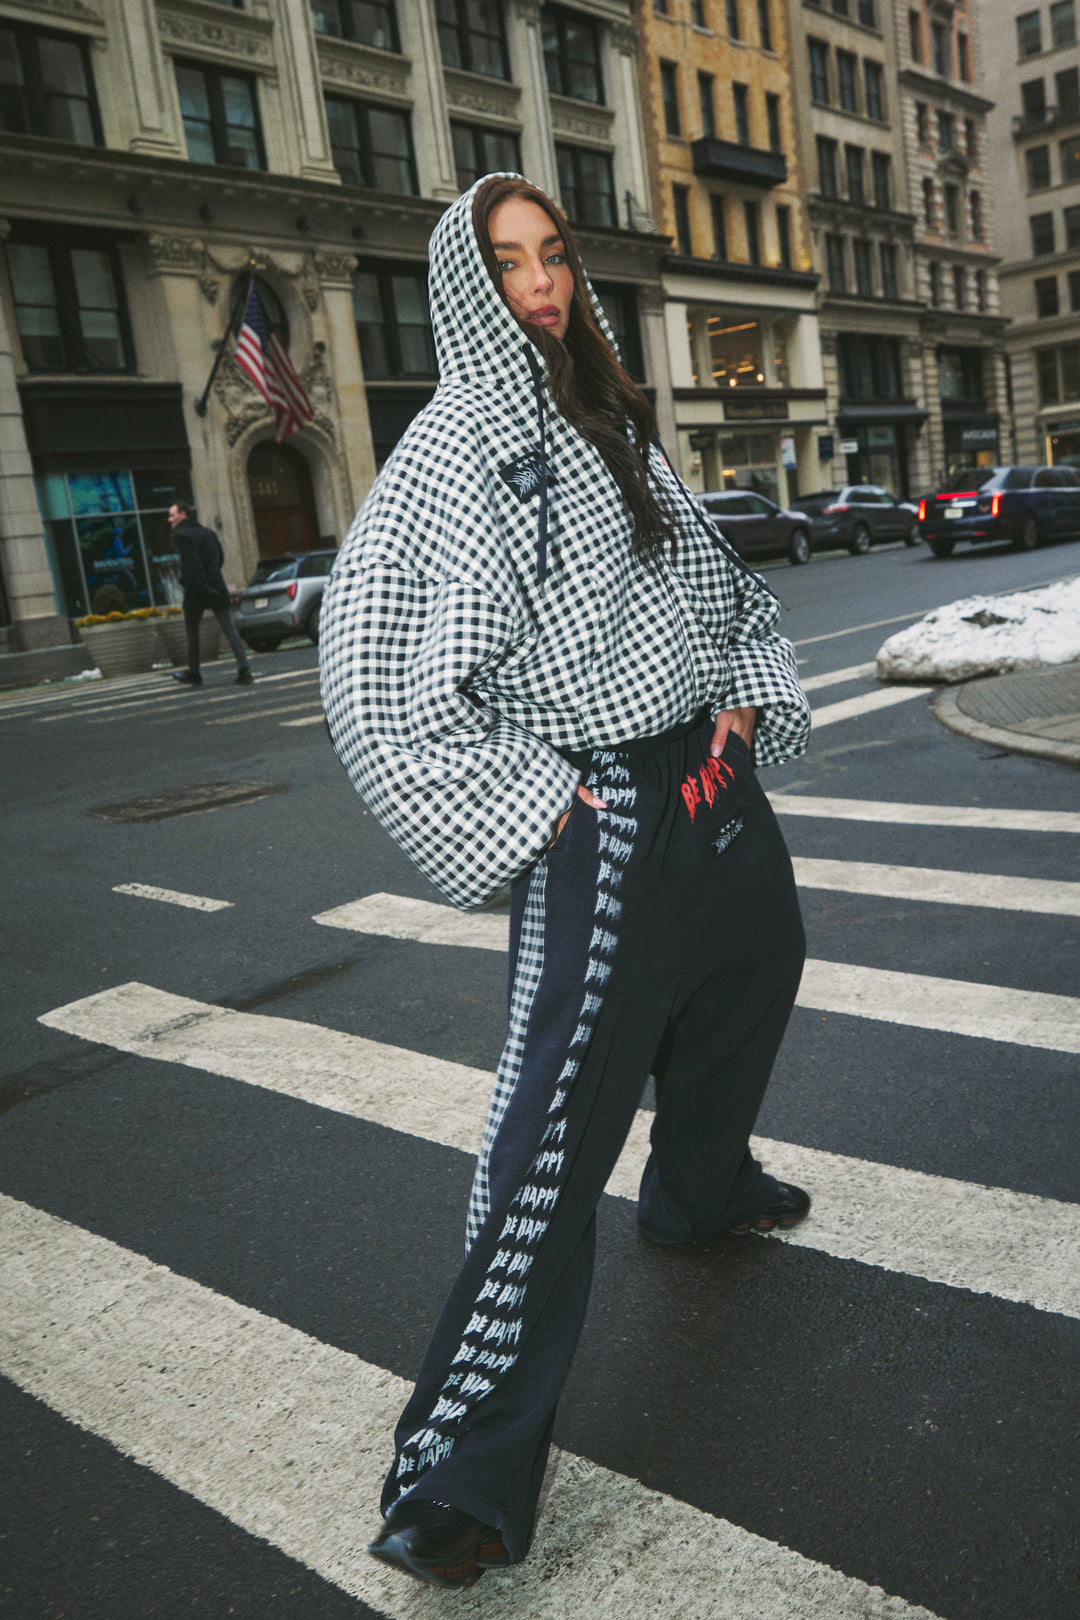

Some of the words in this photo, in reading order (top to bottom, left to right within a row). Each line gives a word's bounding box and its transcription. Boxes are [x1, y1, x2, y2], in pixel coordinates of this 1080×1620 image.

[602, 785, 637, 810] HAPPY
[680, 773, 702, 824] BE
[598, 828, 609, 854] BE
[596, 858, 612, 885] BE
[594, 889, 608, 916] BE
[589, 924, 603, 952] BE
[584, 956, 598, 984] BE
[579, 990, 593, 1017] BE
[568, 1021, 586, 1048] BE
[556, 1056, 576, 1084] BE
[520, 1183, 560, 1213] HAPPY
[497, 1214, 518, 1242] BE
[486, 1247, 512, 1273] BE
[474, 1278, 501, 1304] BE
[461, 1311, 489, 1336] BE
[450, 1341, 477, 1366] BE
[440, 1372, 464, 1391] BE
[428, 1394, 453, 1420] BE
[396, 1452, 415, 1480] BE
